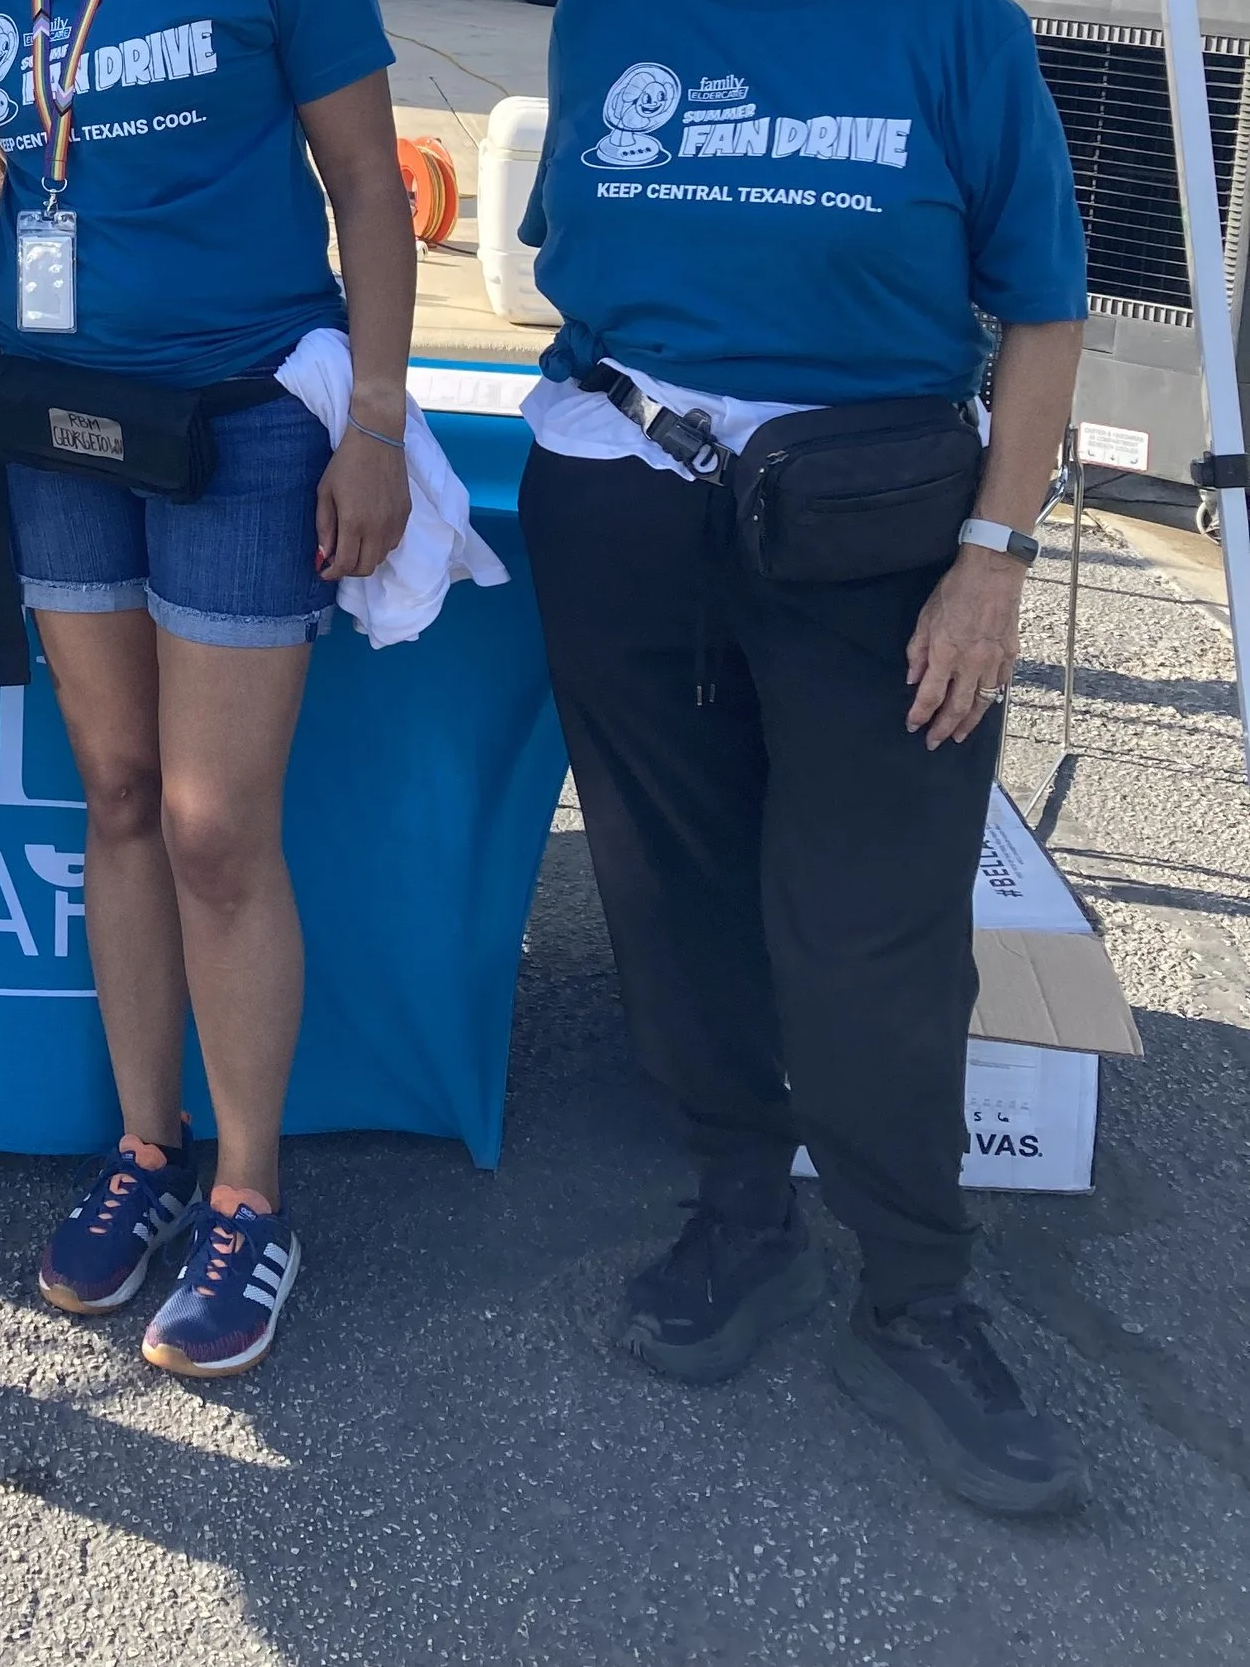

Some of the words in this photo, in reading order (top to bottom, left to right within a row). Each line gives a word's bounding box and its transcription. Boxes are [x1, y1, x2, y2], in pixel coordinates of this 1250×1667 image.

[95, 20, 217, 92] DRIVE
[700, 74, 745, 90] family
[82, 119, 148, 141] TEXANS
[152, 109, 207, 132] COOL.
[682, 103, 756, 124] SUMMER
[678, 117, 770, 158] FAN
[771, 116, 912, 168] DRIVE
[597, 183, 643, 198] KEEP
[646, 184, 733, 202] CENTRAL
[737, 187, 816, 205] TEXANS
[820, 191, 882, 213] COOL.
[68, 413, 101, 431] RBM
[965, 1133, 1043, 1157] VAS.
